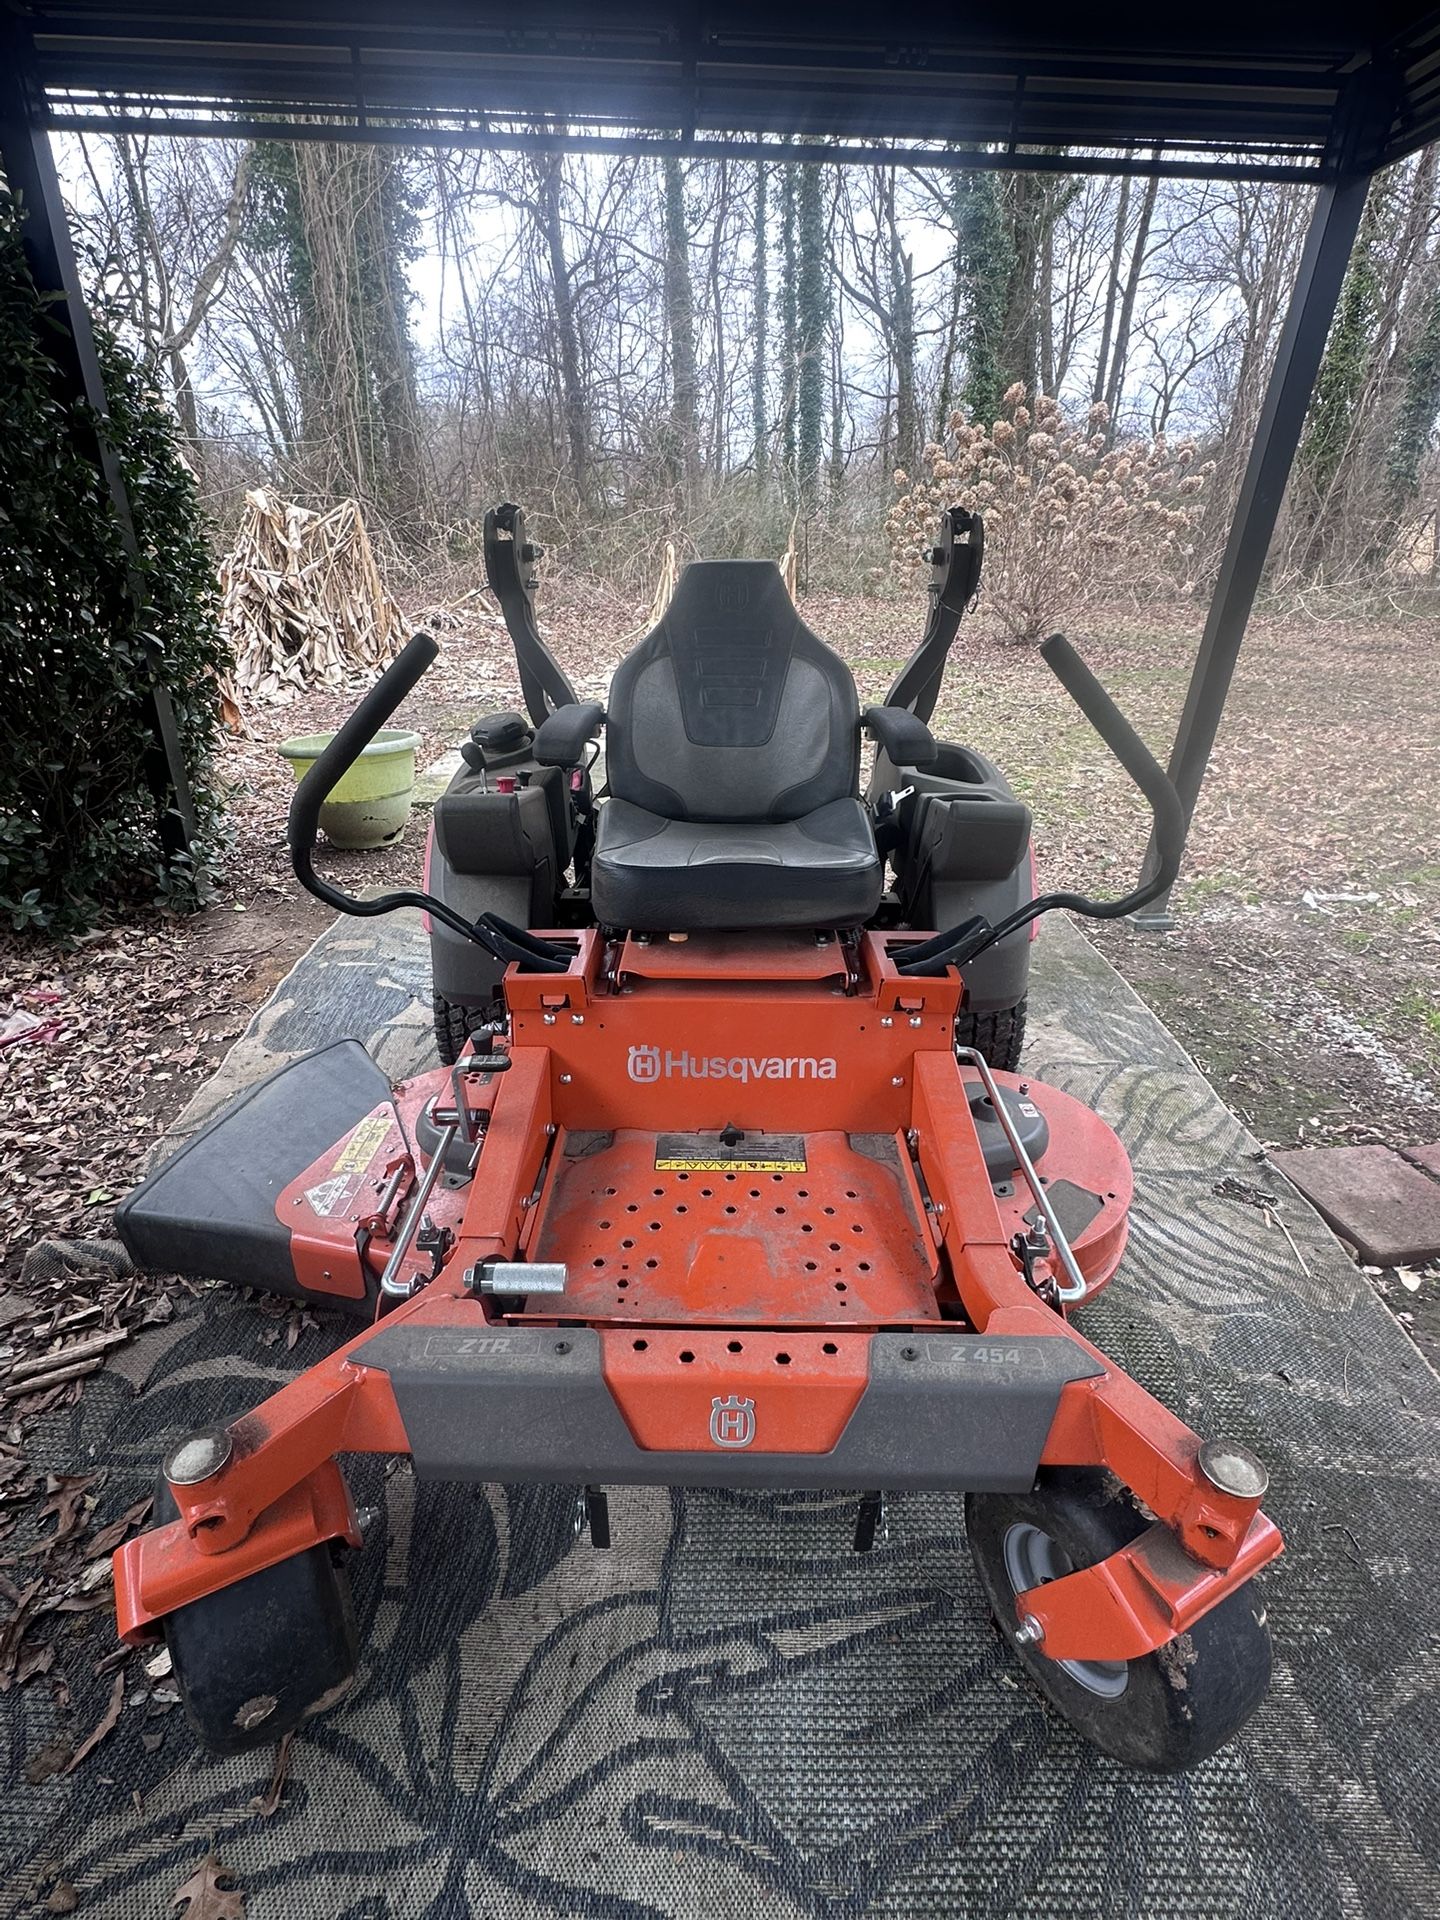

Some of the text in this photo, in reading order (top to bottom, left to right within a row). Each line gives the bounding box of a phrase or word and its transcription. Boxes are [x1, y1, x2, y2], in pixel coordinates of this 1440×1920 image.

[665, 1050, 837, 1083] Husqvarna
[457, 1338, 512, 1353] ZTR
[950, 1346, 1021, 1364] Z 454
